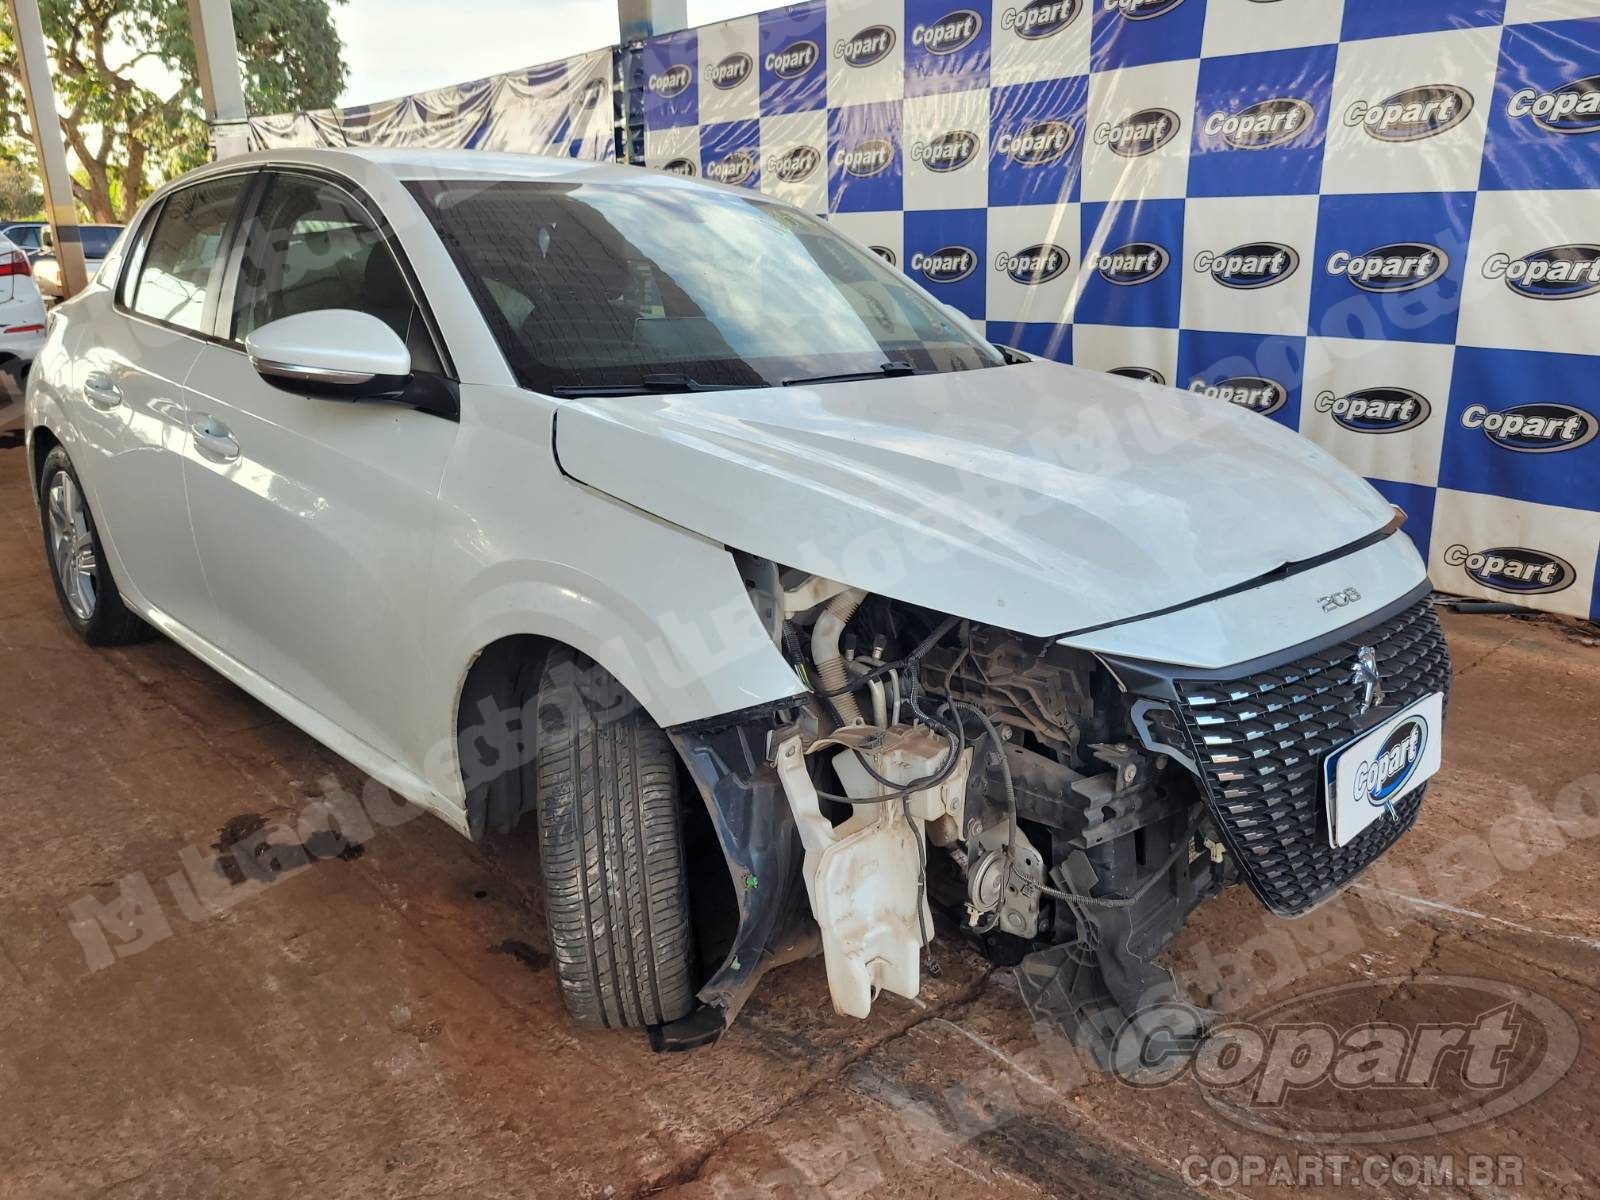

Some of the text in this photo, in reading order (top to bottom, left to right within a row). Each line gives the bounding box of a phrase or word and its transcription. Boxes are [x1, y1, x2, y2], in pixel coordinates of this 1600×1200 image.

[1001, 0, 1071, 30] Copart
[912, 16, 972, 46] Copart
[834, 34, 887, 59] Copart
[704, 60, 747, 83] Copart
[765, 50, 812, 73] Copart
[648, 71, 687, 92] Copart
[1343, 92, 1457, 131] Copart
[1506, 88, 1600, 123] Copa
[1094, 115, 1168, 147] Copart
[1204, 109, 1298, 139] Copart
[911, 140, 969, 166] Copart
[998, 129, 1065, 156] Copart
[707, 160, 750, 182] Copart
[767, 154, 814, 177] Copart
[834, 146, 886, 170] Copart
[911, 252, 969, 275] Copart
[995, 250, 1059, 277] Copart
[1088, 250, 1160, 277] Copart
[1194, 250, 1285, 279] Copart
[1326, 252, 1434, 283] Copart
[1314, 390, 1415, 422] Copart
[1461, 404, 1582, 440] Copart
[1444, 544, 1558, 587] Copart
[1317, 586, 1362, 613] 208
[1353, 721, 1421, 801] Copart
